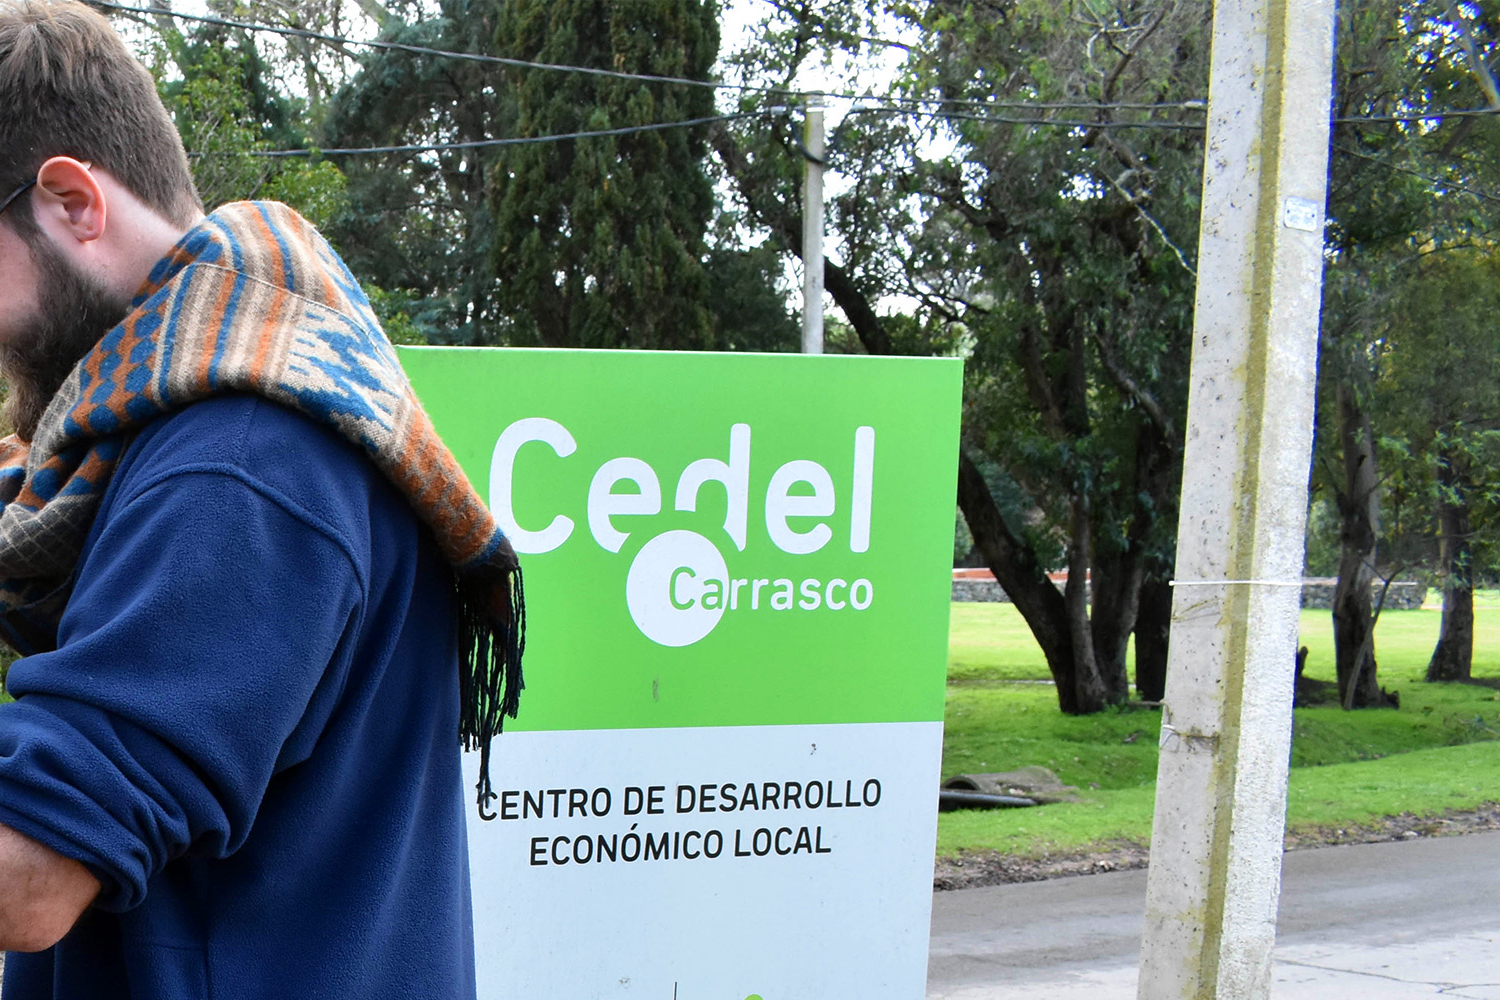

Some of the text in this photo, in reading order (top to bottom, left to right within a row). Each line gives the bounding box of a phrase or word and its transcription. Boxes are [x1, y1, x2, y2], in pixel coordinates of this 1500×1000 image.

[489, 416, 876, 555] Cedel
[668, 566, 874, 611] Carrasco
[478, 778, 882, 821] CENTRO DE DESARROLLO
[530, 822, 832, 866] ECONÓMICO LOCAL
